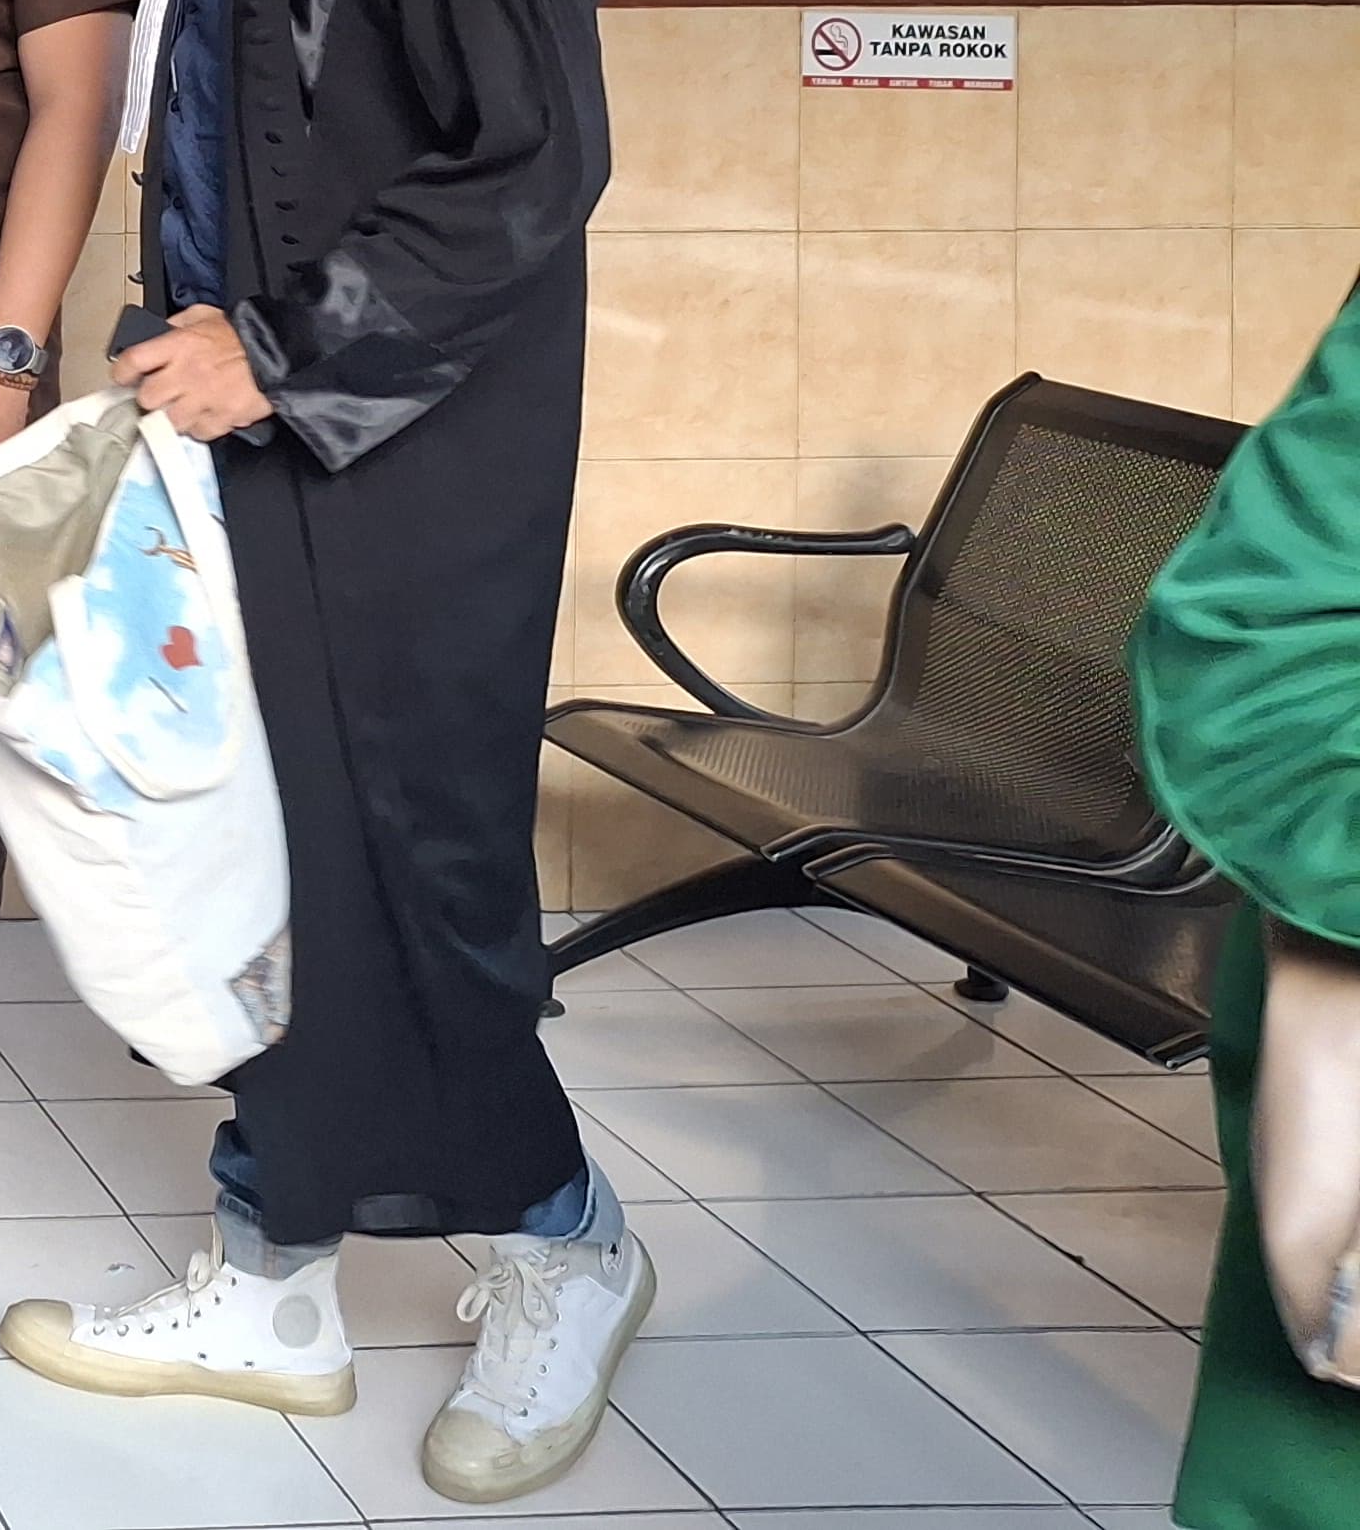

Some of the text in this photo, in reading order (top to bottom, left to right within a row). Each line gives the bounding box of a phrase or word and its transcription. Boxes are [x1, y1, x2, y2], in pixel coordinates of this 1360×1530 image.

[891, 23, 986, 40] KAWASAN
[870, 41, 1007, 58] TANPA ROKOK
